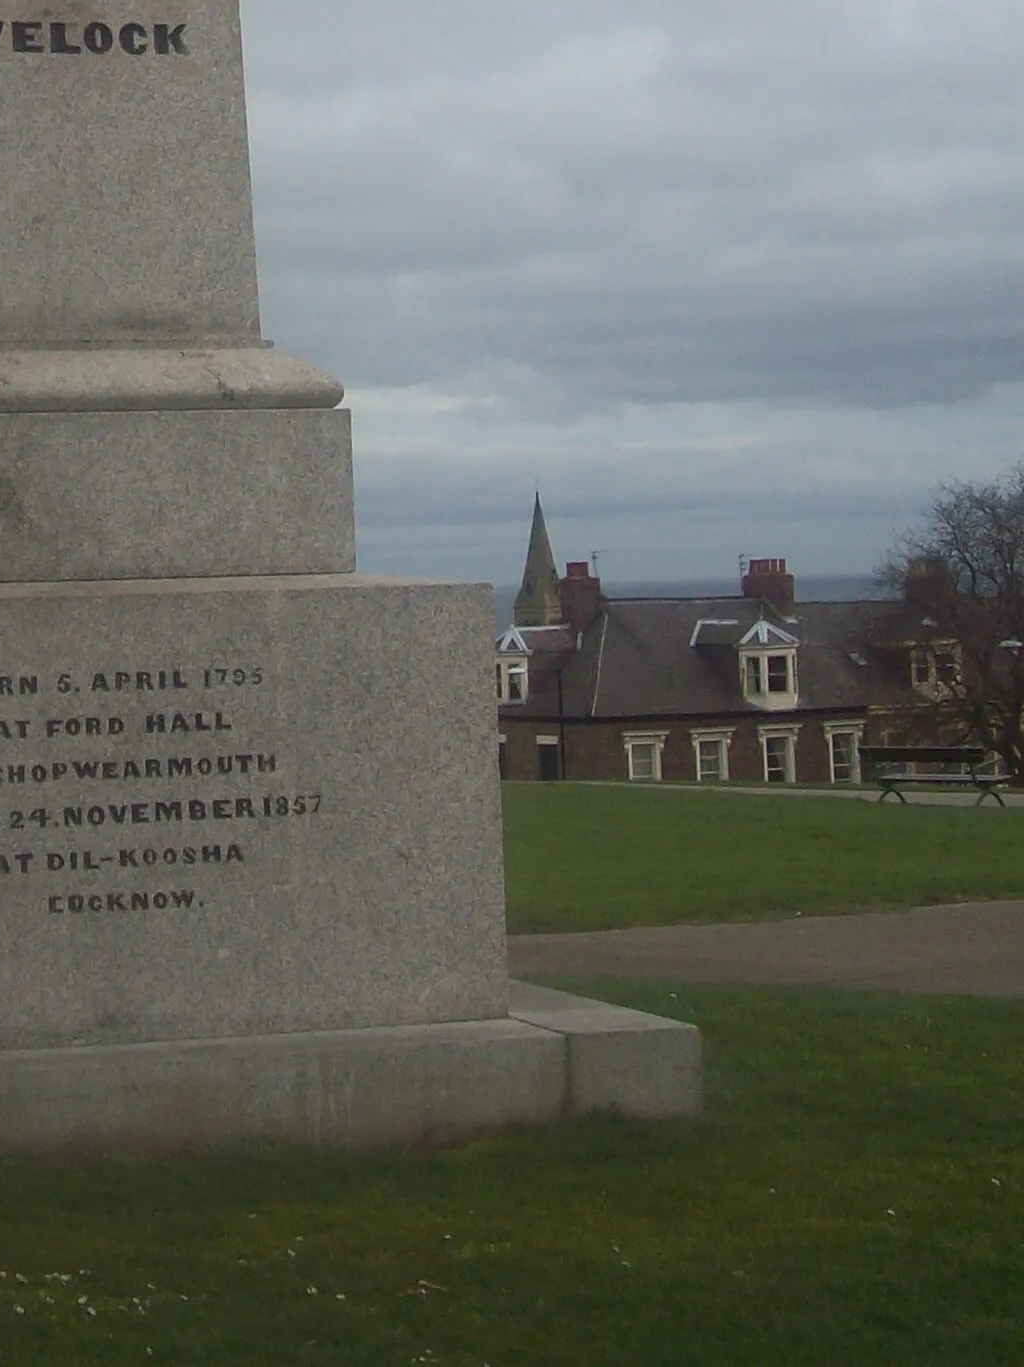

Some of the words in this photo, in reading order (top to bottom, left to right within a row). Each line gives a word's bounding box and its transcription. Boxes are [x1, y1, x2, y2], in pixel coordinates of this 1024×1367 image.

[56, 673, 80, 694] 5.
[91, 669, 188, 692] APRIL
[203, 668, 263, 689] 1795
[46, 717, 124, 738] FORD
[145, 712, 232, 733] HALL
[10, 807, 60, 829] 24.
[63, 798, 255, 827] NOVEMBER
[262, 794, 322, 818] 1857
[46, 843, 244, 871] DIL-KOOSHA
